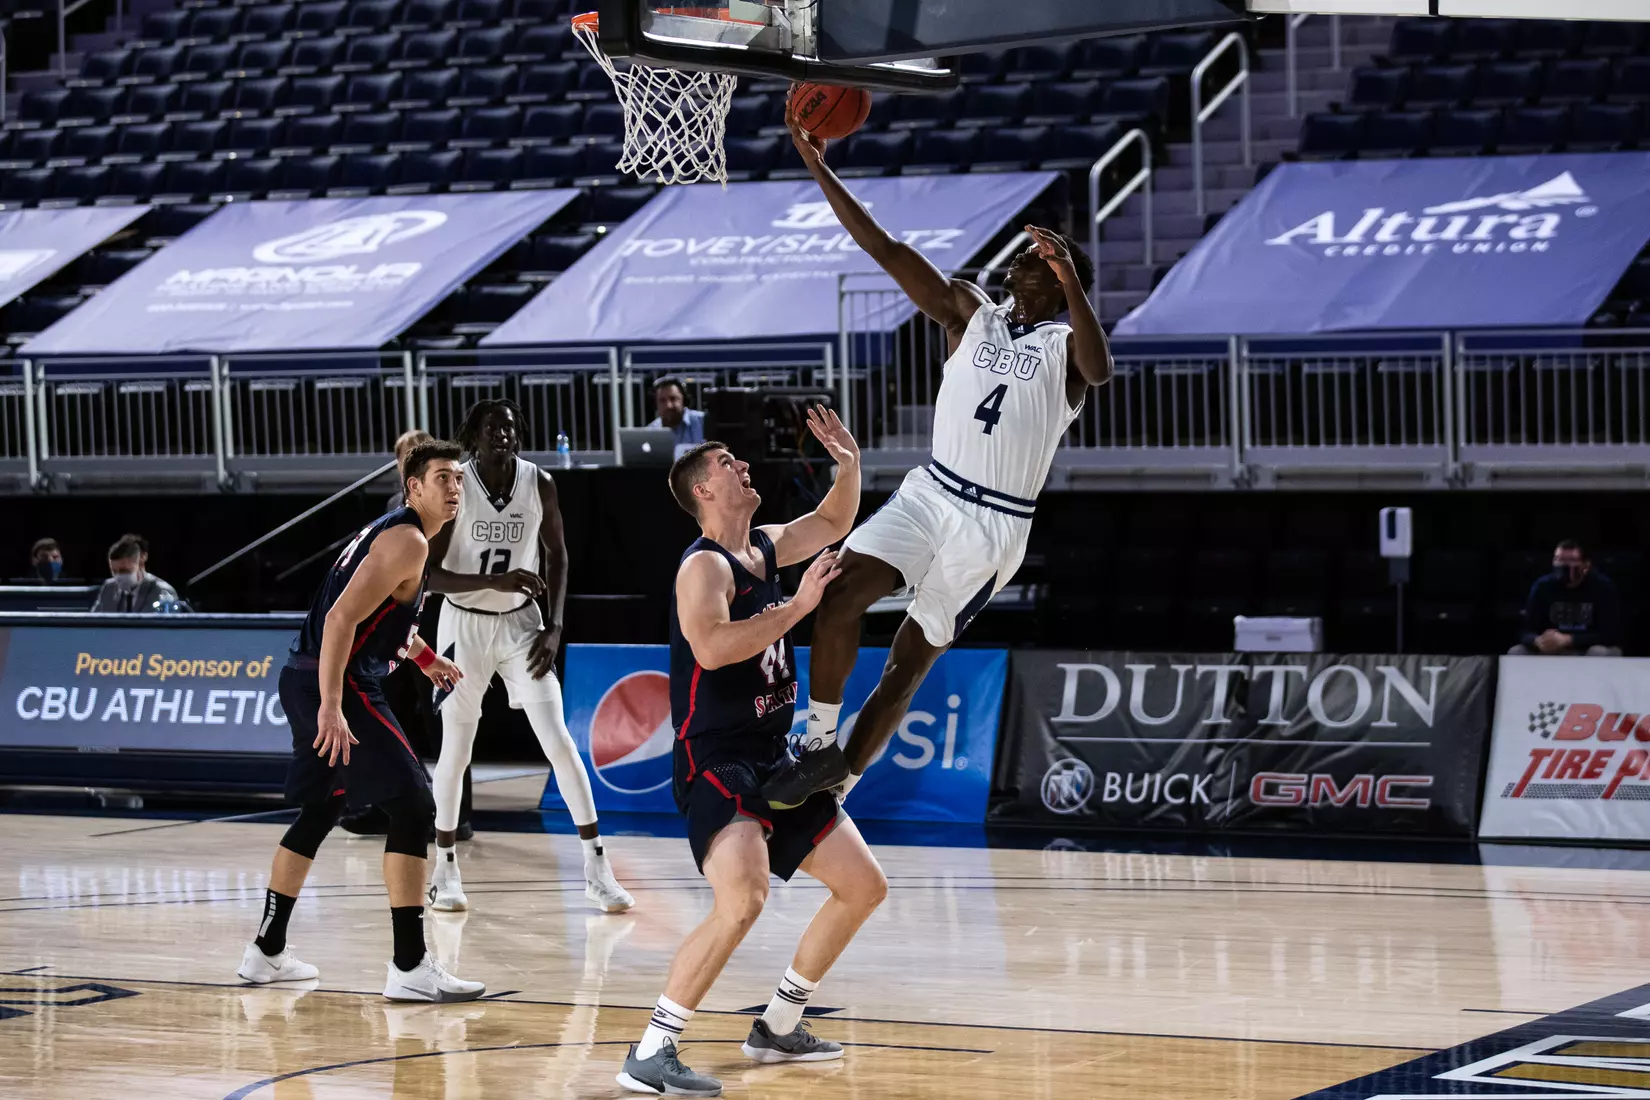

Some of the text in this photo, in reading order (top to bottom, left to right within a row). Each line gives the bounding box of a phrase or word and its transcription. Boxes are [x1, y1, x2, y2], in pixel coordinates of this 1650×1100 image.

[800, 90, 827, 121] NCAA
[1264, 207, 1561, 244] Altura
[622, 228, 966, 257] TOVEY/SHUTZ
[1324, 241, 1550, 257] CREDIT UNION
[973, 341, 1041, 381] CBU
[1025, 344, 1042, 353] WAC
[974, 383, 1008, 435] 4
[472, 520, 524, 543] CBU
[75, 653, 273, 681] Proud Sponsor of
[16, 686, 98, 720] CBU
[1050, 663, 1447, 728] DUTTON
[1103, 772, 1214, 805] BUICK
[1511, 748, 1616, 798] TIRE
[1249, 772, 1433, 809] GMC
